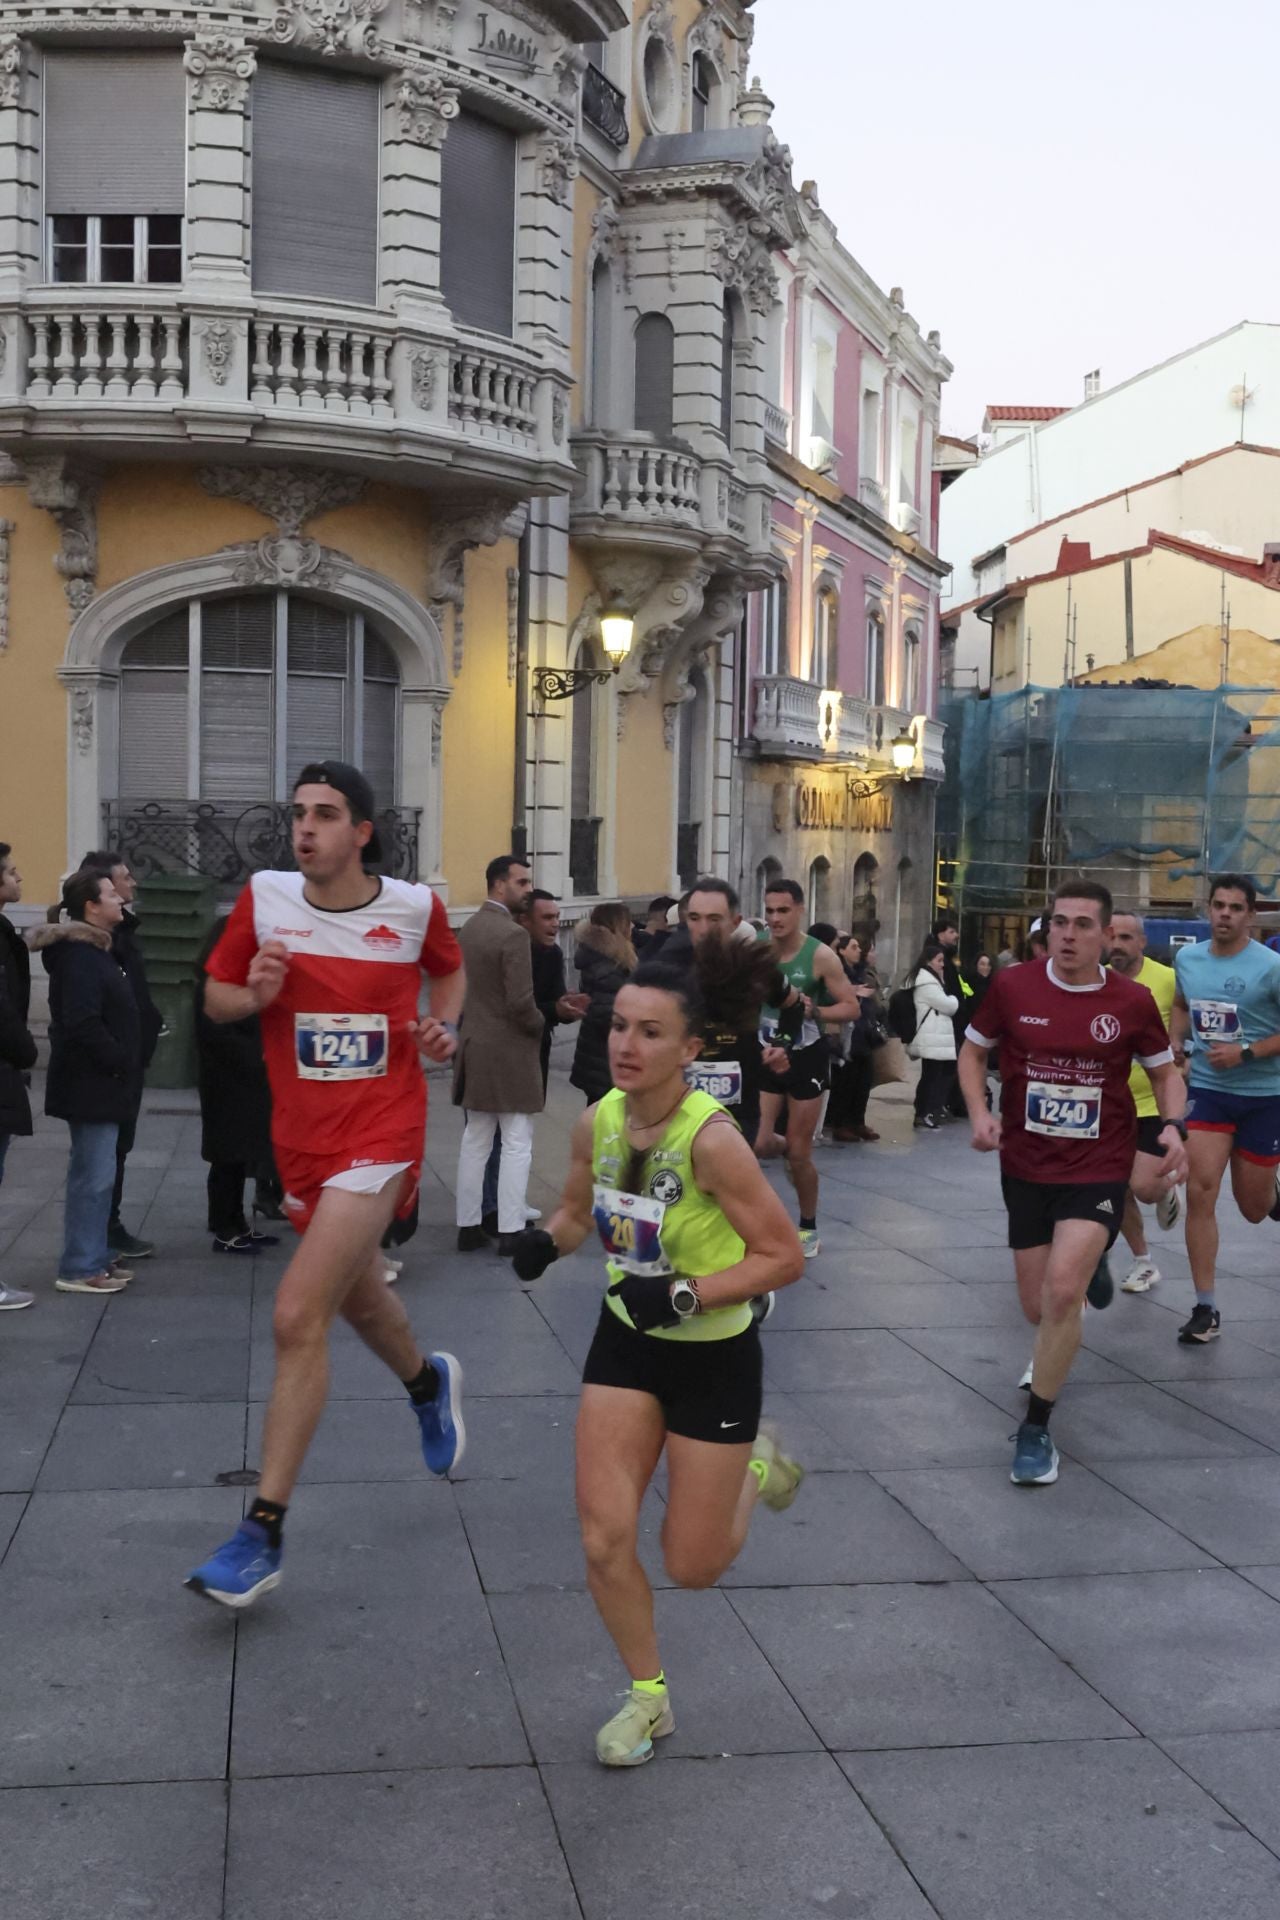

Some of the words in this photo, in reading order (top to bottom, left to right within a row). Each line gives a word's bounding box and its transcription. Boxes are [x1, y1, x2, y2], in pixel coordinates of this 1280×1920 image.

[1201, 1011, 1226, 1030] 827
[311, 1034, 369, 1062] 1241
[1038, 1099, 1088, 1124] 1240
[609, 1214, 635, 1249] 20
